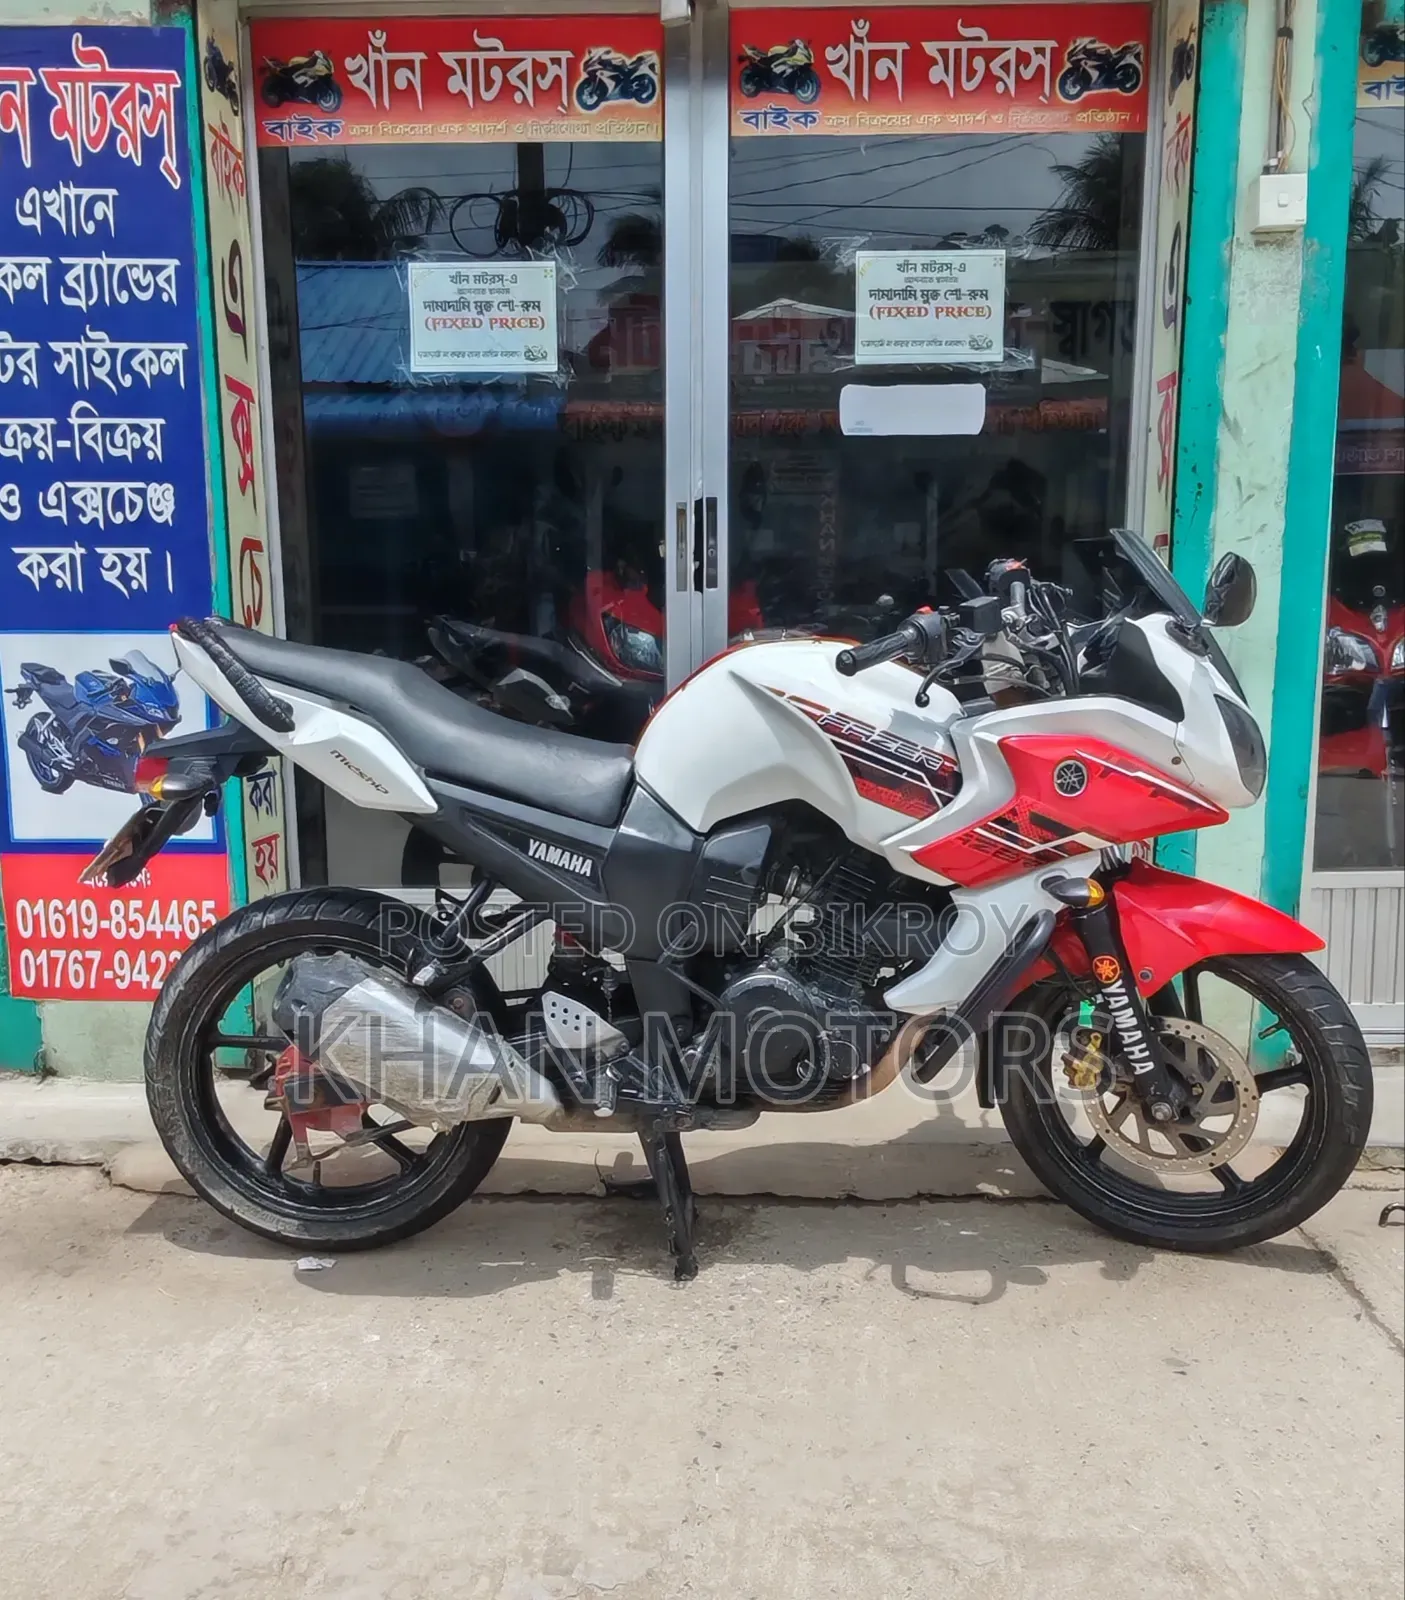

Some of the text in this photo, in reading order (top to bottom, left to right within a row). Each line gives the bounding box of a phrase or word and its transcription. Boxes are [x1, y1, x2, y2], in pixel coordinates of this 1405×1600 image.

[345, 28, 576, 114] খাঁন মটরস্
[824, 18, 1059, 104] খাঁন মটরস্
[0, 32, 181, 189] ন মটরস্
[262, 113, 345, 142] বাইক
[738, 103, 822, 132] বাইক
[16, 180, 118, 238] এখানে
[0, 251, 181, 313] কল ব্র্যান্ডের
[424, 316, 545, 331] (FIXED PRICE)
[869, 305, 992, 320] (FIXED PRICE)
[0, 324, 188, 396] টর সাইকেল
[11, 541, 87, 593] করা
[94, 547, 152, 599] হয়
[527, 838, 593, 878] YAMAHA
[16, 899, 217, 940] 01619-854465
[20, 949, 182, 990] 01767-942
[1101, 978, 1155, 1076] YAMAHA
